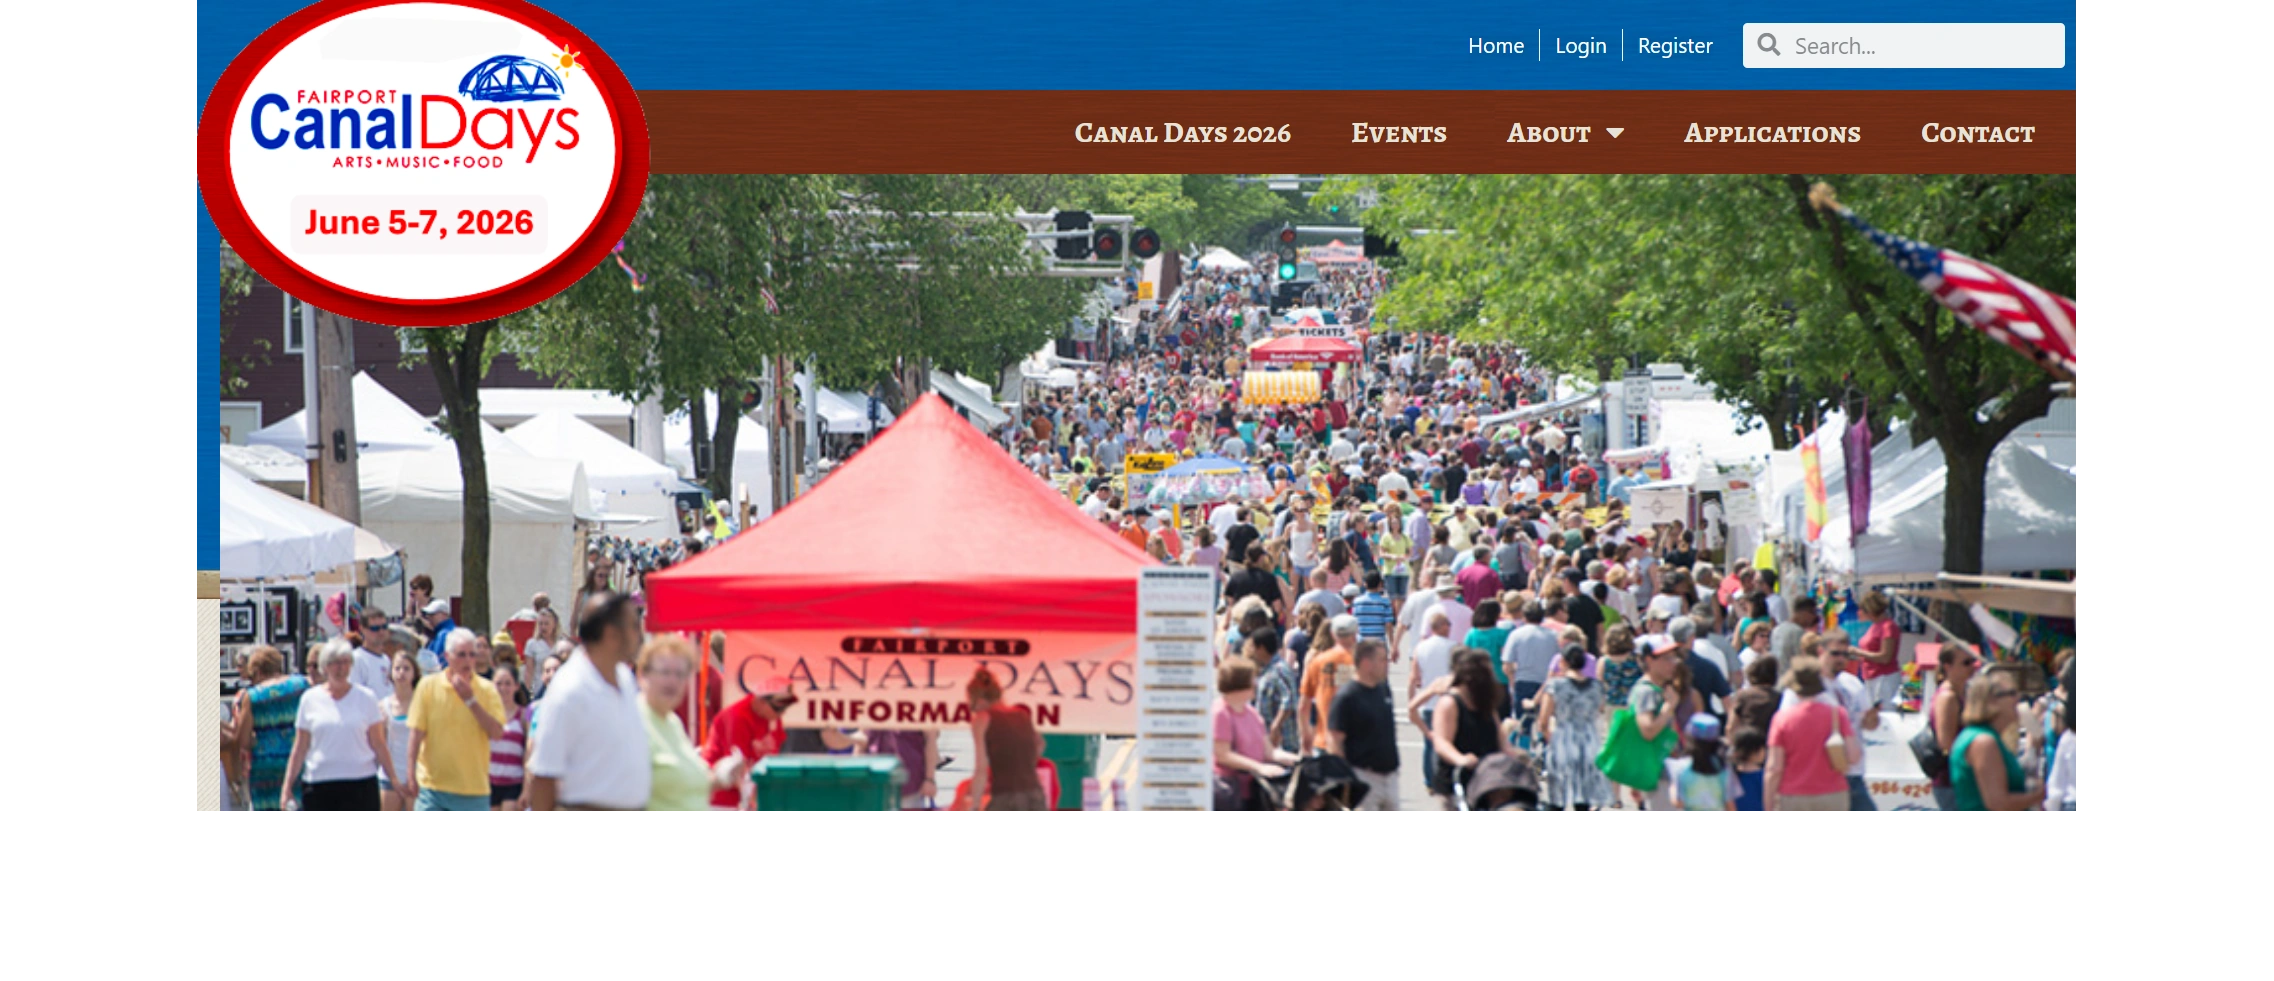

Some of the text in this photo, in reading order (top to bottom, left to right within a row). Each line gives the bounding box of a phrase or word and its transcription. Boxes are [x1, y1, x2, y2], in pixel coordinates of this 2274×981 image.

[1300, 327, 1345, 337] TICKETS
[854, 638, 1016, 653] FAIRPORT
[738, 655, 1134, 705] CANAL DAYS
[808, 699, 1060, 726] INFORMAN
